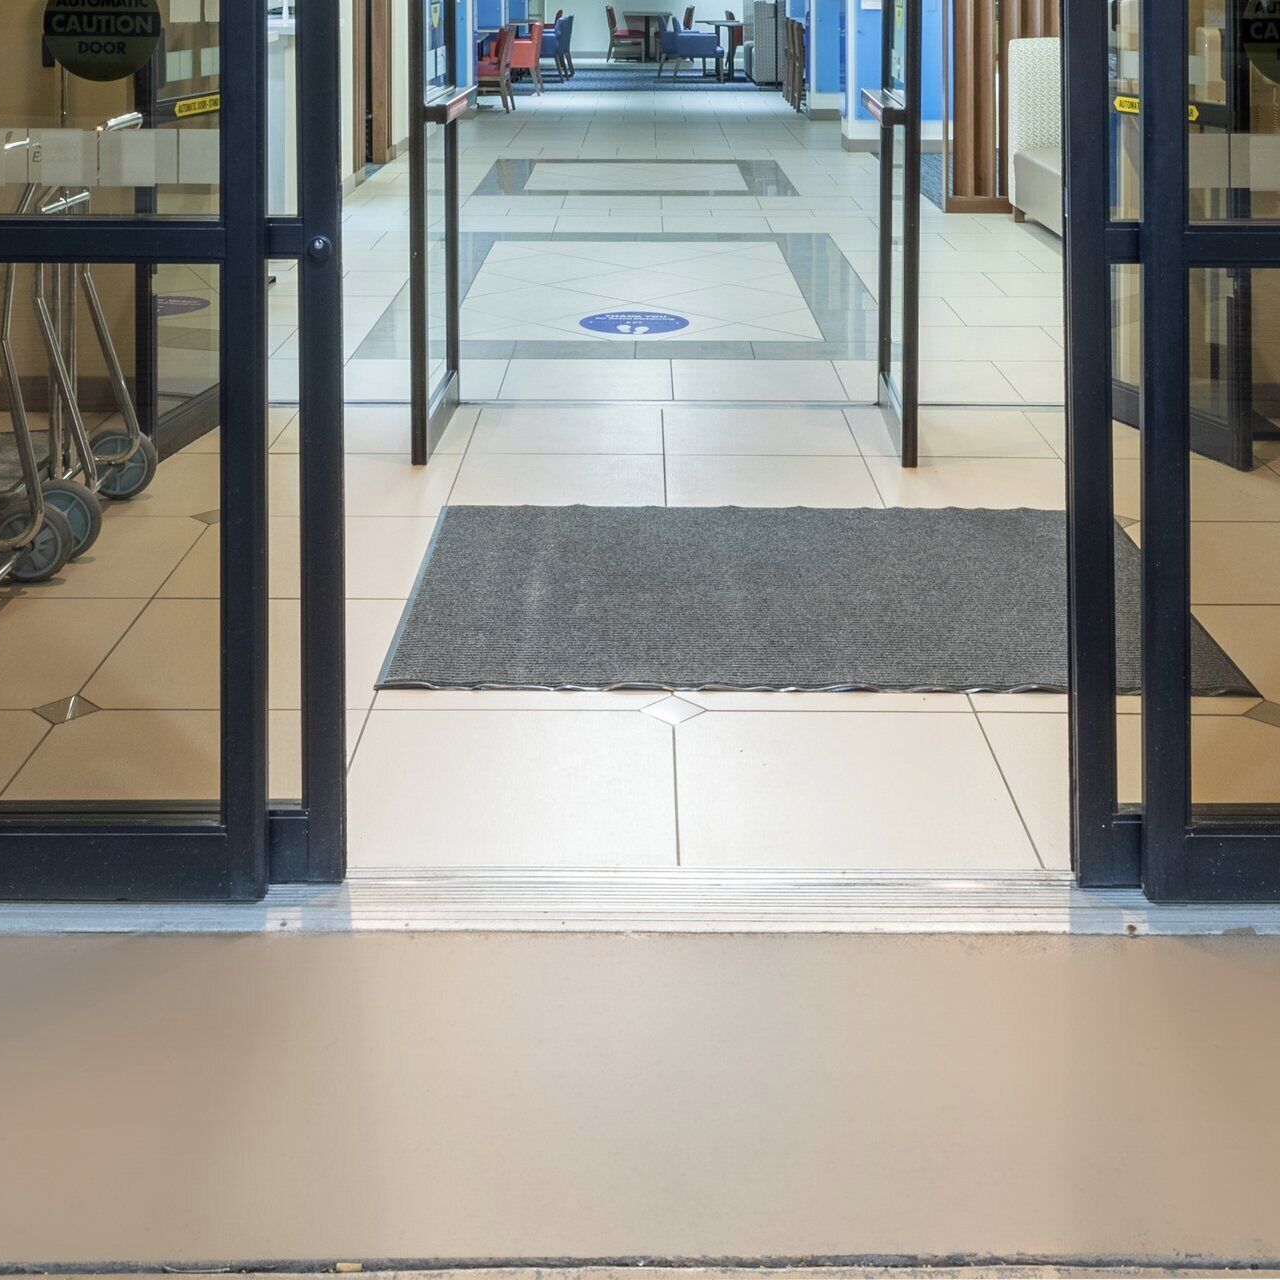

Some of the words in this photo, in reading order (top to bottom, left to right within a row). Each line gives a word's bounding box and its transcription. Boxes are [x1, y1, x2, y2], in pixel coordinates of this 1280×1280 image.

[51, 14, 153, 34] CAUTION
[78, 41, 126, 54] DOOR
[178, 101, 197, 113] AUTOMATIC
